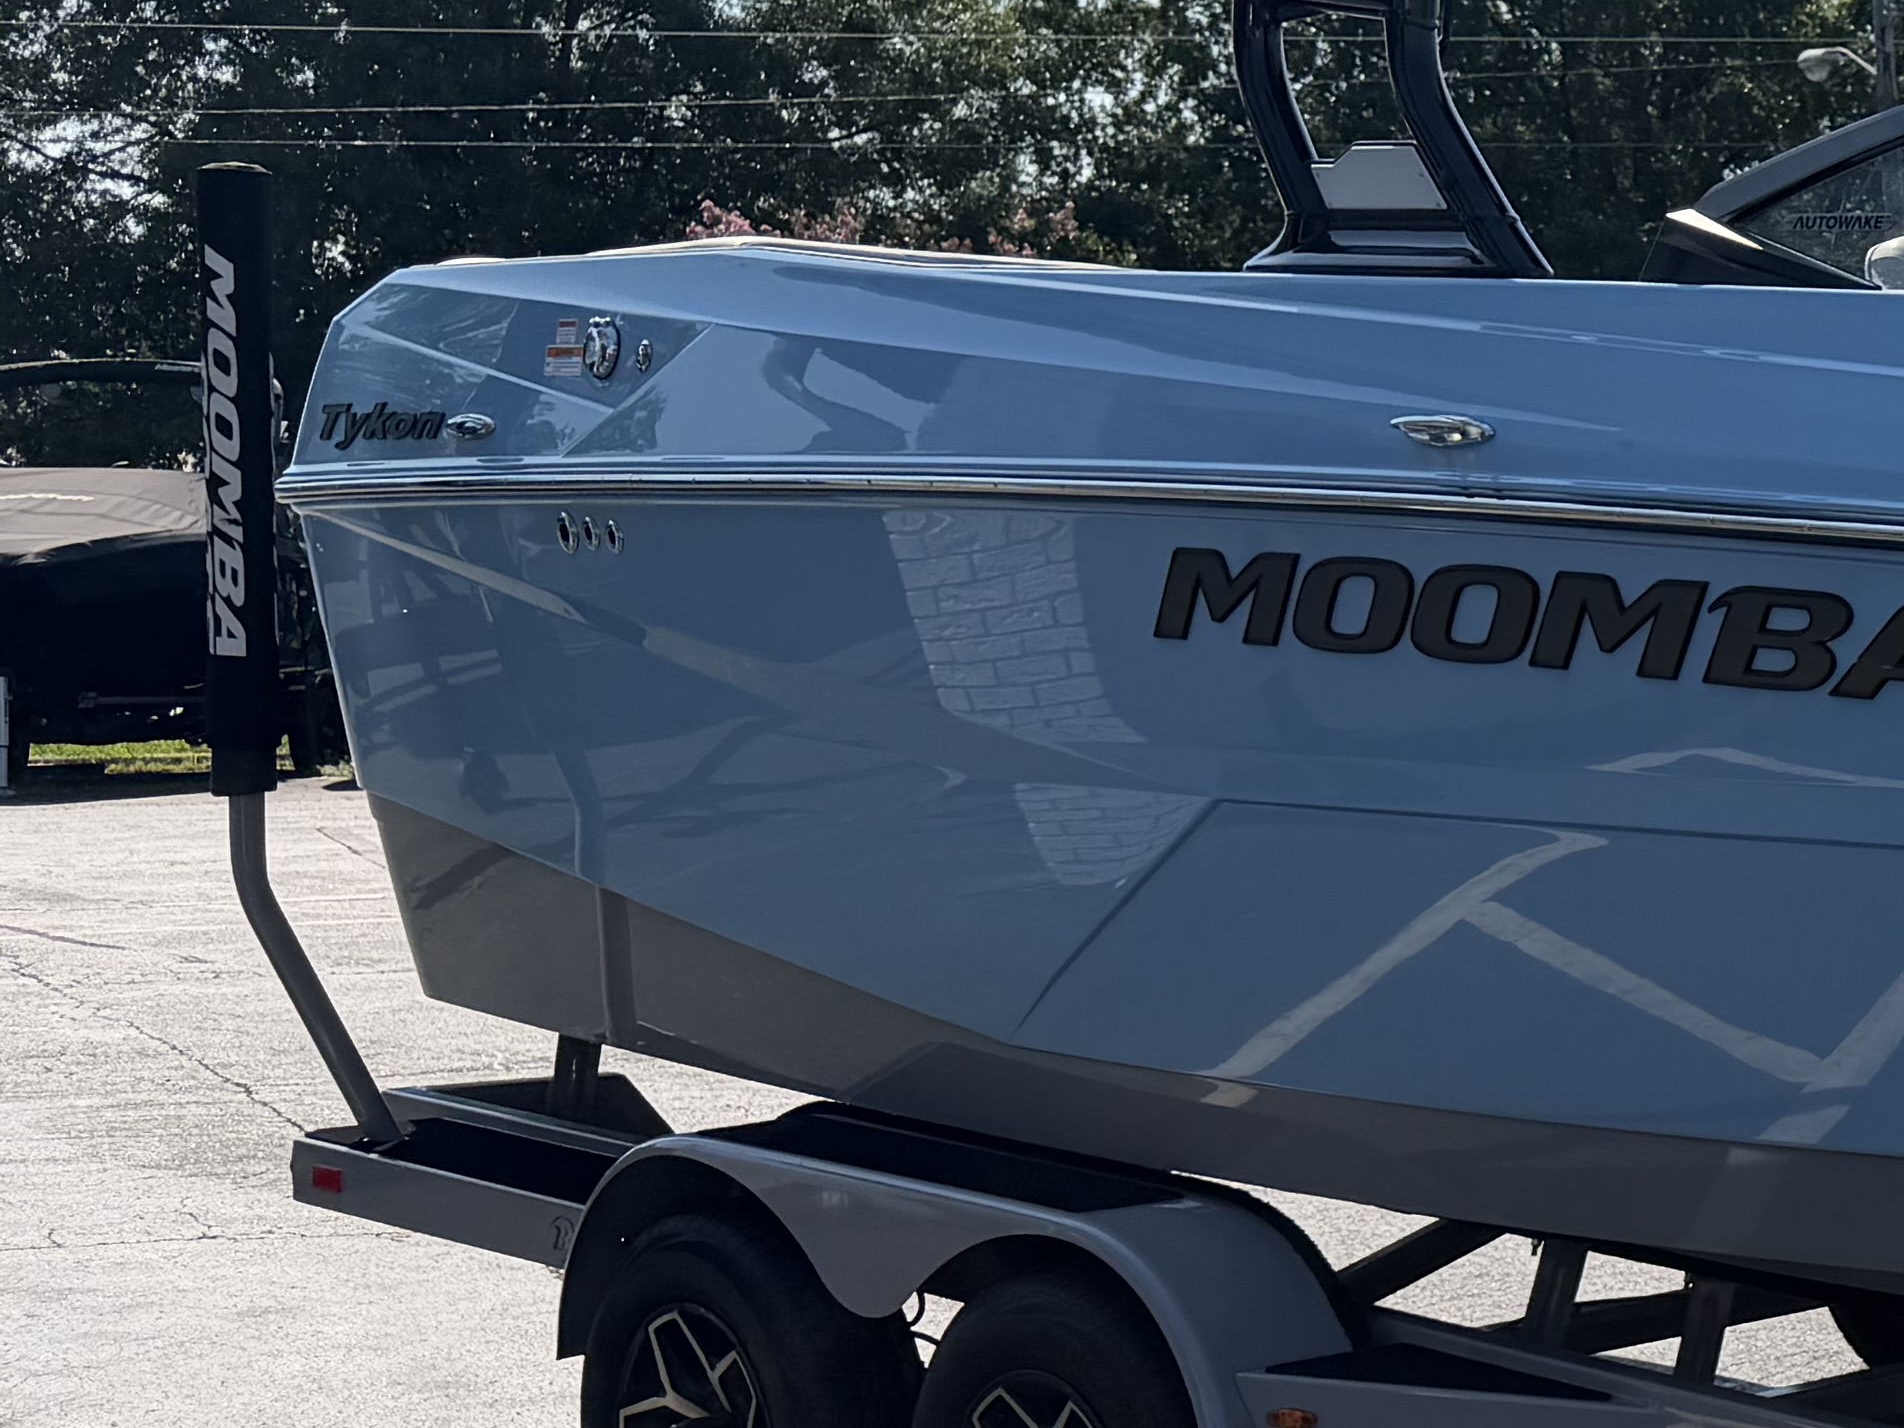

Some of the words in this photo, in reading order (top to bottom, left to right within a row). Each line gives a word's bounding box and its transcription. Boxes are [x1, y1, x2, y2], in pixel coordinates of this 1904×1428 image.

[1793, 215, 1885, 230] AUTOWAKE
[319, 401, 446, 448] Tykon
[204, 245, 247, 657] MOOMBA
